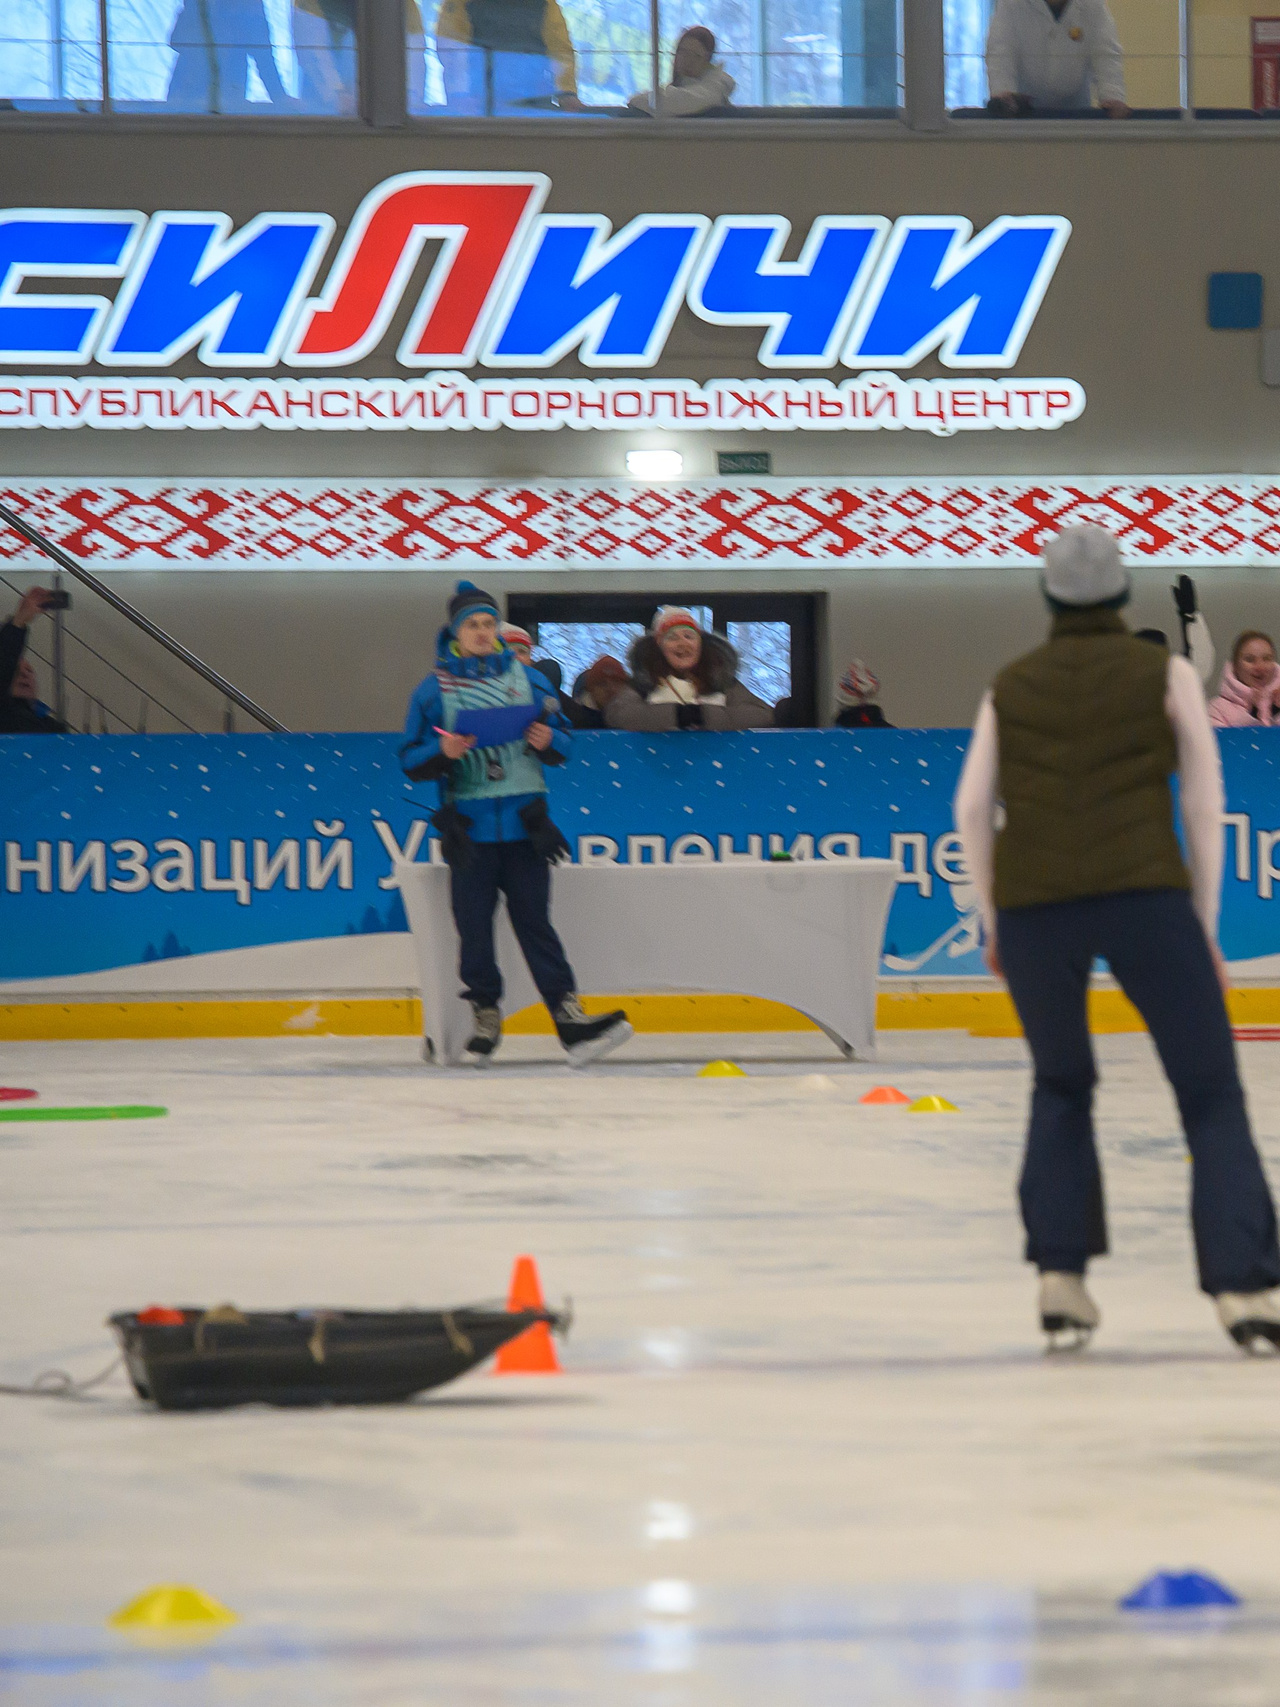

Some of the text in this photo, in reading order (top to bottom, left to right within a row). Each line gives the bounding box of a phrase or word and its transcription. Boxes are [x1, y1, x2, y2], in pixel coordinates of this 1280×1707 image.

[481, 383, 896, 418] ГОРНОЛЫЖНЫЙ
[912, 390, 1072, 423] ЦЕНТР
[5, 819, 353, 905] низаций
